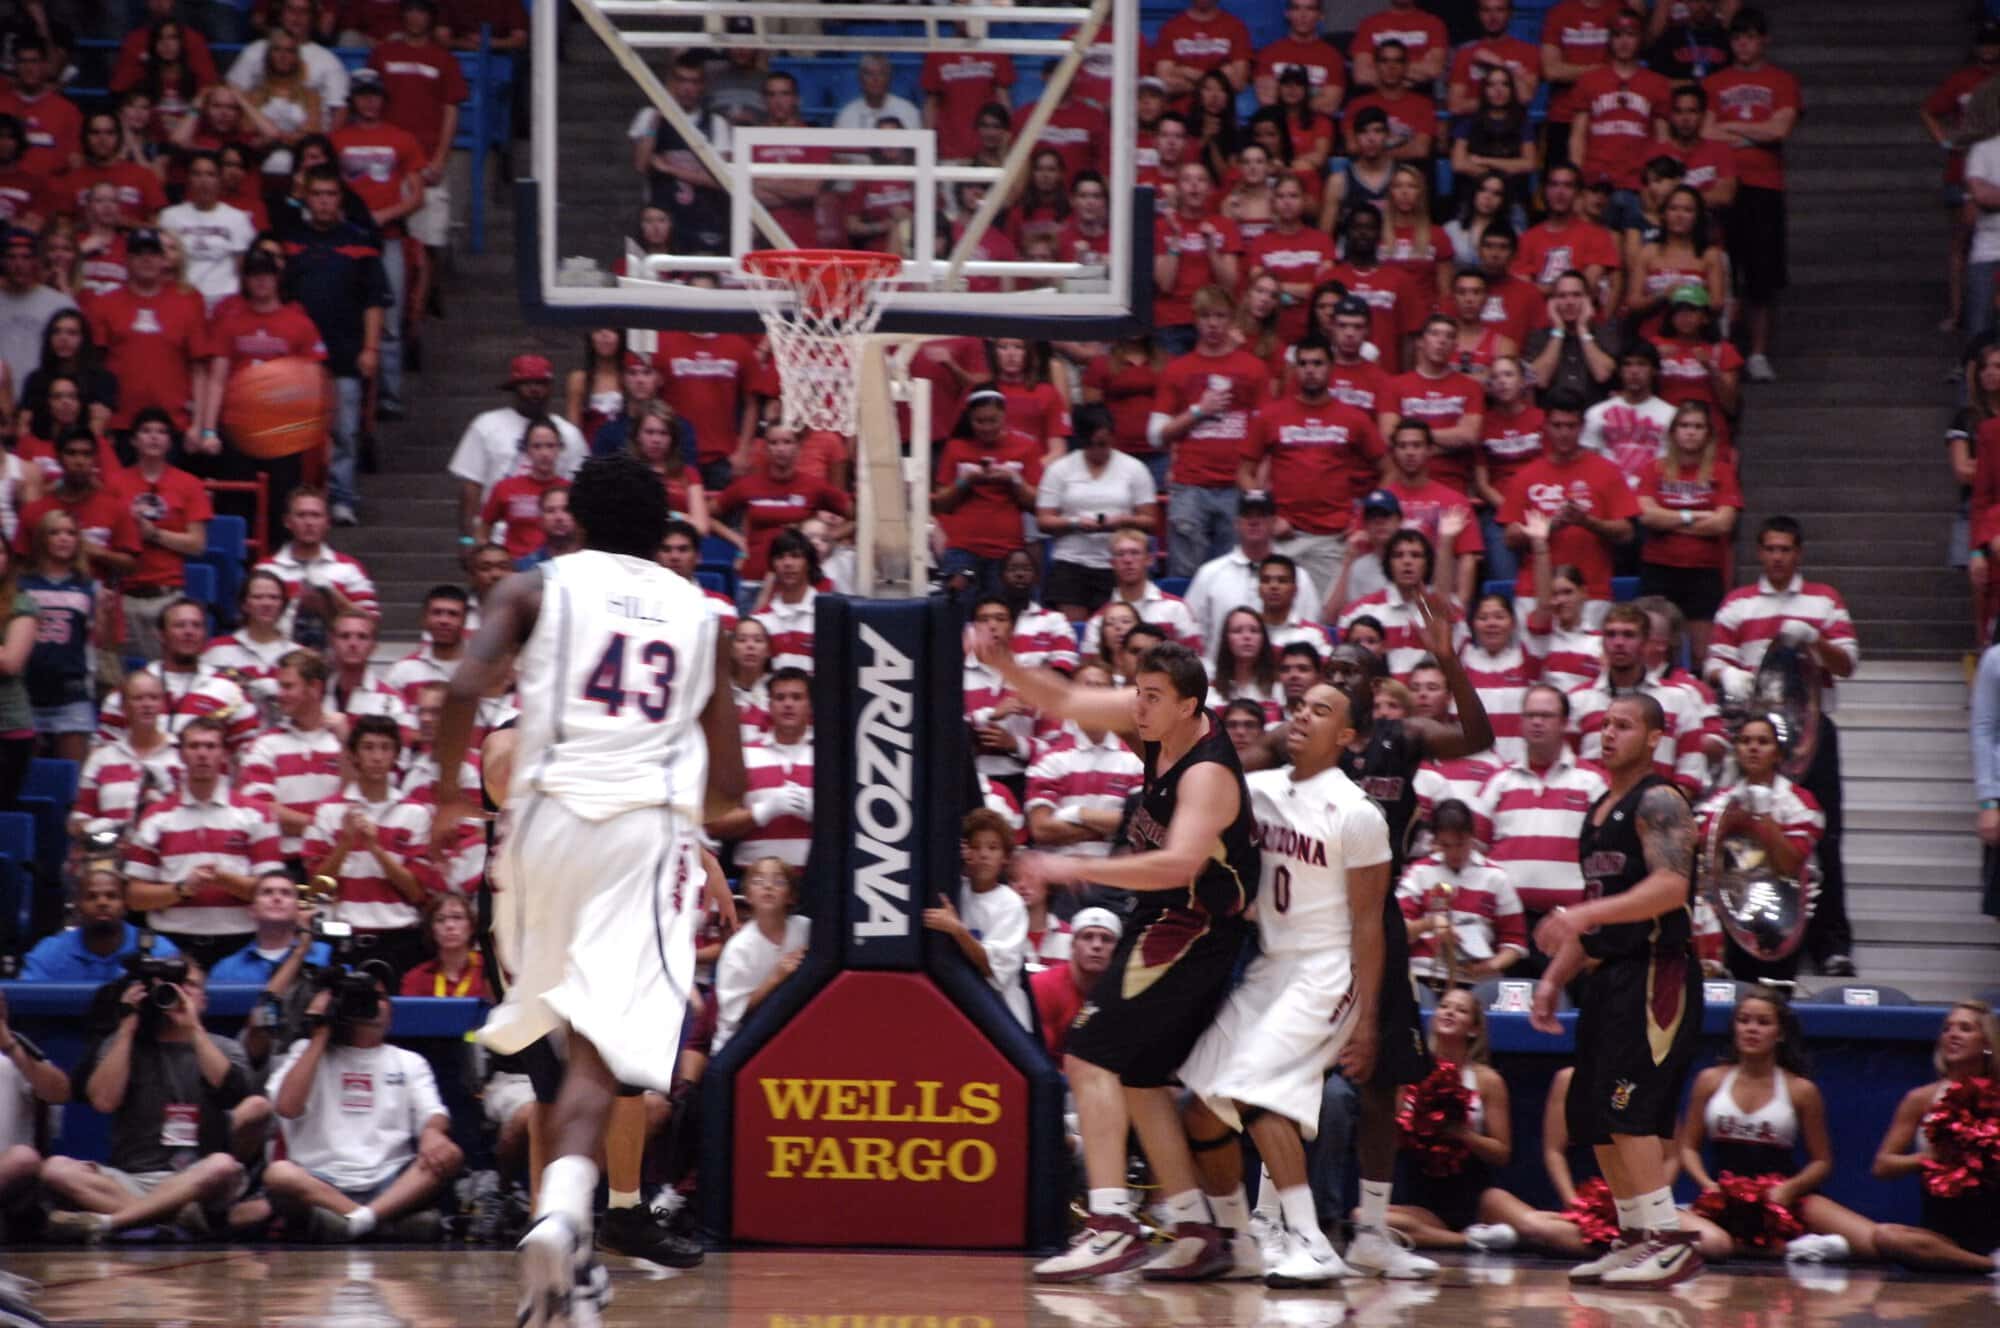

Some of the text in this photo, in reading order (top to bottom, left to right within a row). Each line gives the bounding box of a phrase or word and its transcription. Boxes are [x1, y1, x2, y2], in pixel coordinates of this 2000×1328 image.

[584, 632, 679, 723] 43
[854, 622, 914, 937] ARIZONA
[1273, 864, 1291, 914] 0
[760, 1077, 1002, 1126] WELLS
[766, 1135, 998, 1183] FARGO
